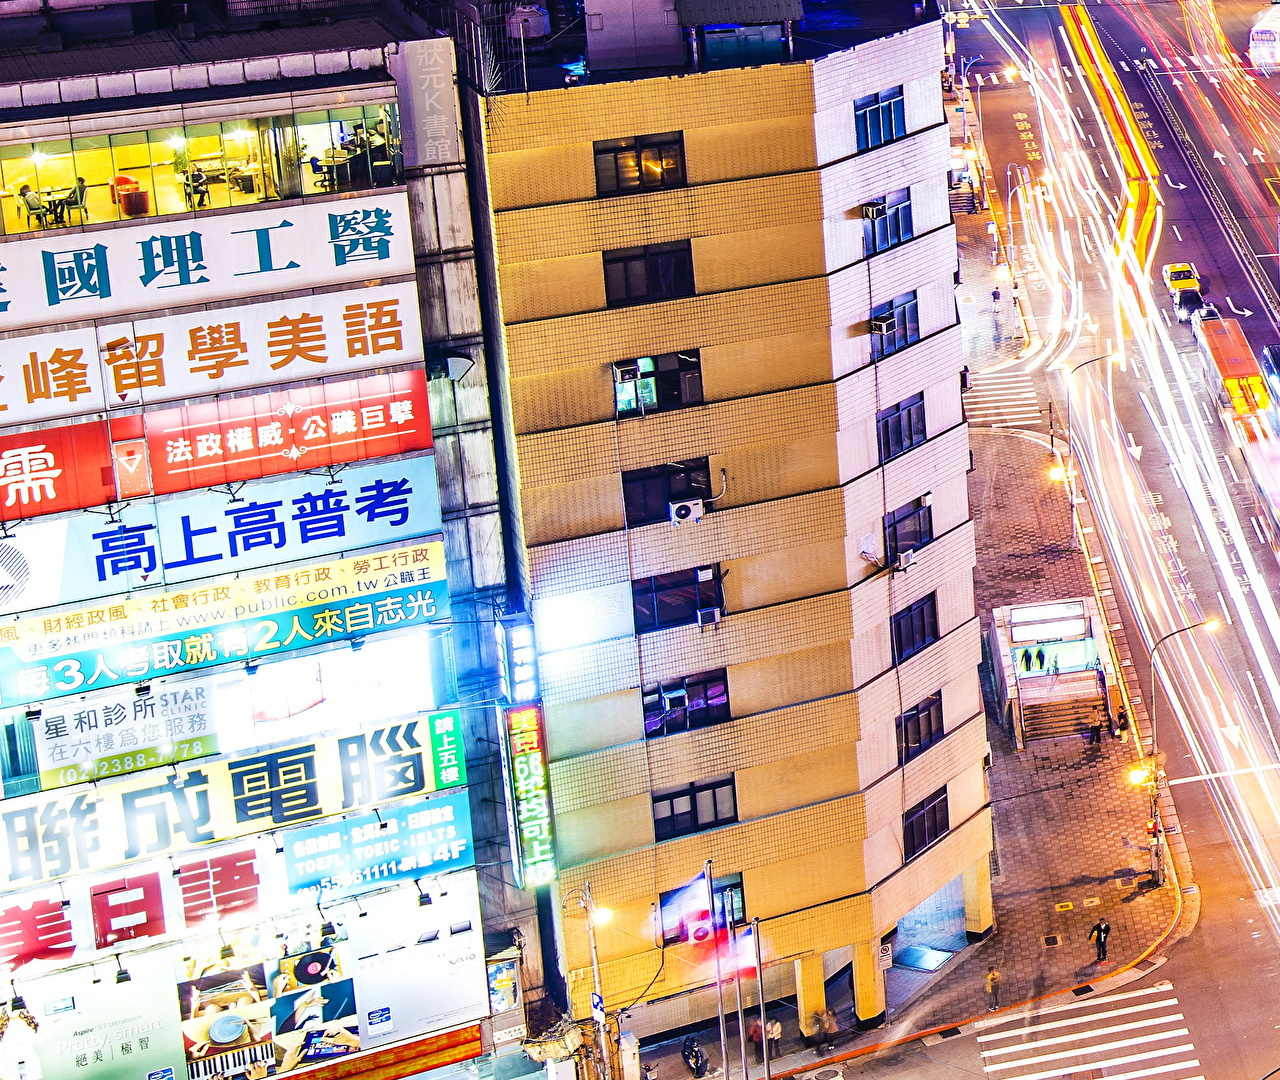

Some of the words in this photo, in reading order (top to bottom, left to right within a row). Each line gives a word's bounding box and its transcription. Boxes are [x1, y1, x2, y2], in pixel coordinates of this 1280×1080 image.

[417, 42, 450, 161] 狀元K書館
[0, 207, 394, 313] 國理工醫
[0, 298, 404, 412] 峰留學美語
[92, 477, 413, 583] 高上高普考
[176, 579, 379, 628] www.public.com.tw
[384, 567, 432, 588] 公職王
[15, 590, 438, 697] 每3人考取就有2人來自志光
[44, 695, 156, 740] 星和診所
[159, 686, 207, 708] STAR
[161, 700, 207, 717] CLINIC
[432, 717, 462, 786] 請上五樓
[2, 721, 427, 883] 聯成電腦
[354, 838, 400, 860] TOEIC
[410, 825, 457, 848] IELTS
[433, 838, 467, 862] 4F
[0, 848, 260, 972] 美日語
[448, 953, 476, 965] VAIO
[56, 1034, 112, 1055] Pretty,
[114, 1019, 163, 1040] smart
[73, 1027, 95, 1037] Aspire
[75, 1050, 104, 1068] 絕美
[120, 1036, 150, 1056] 極智
